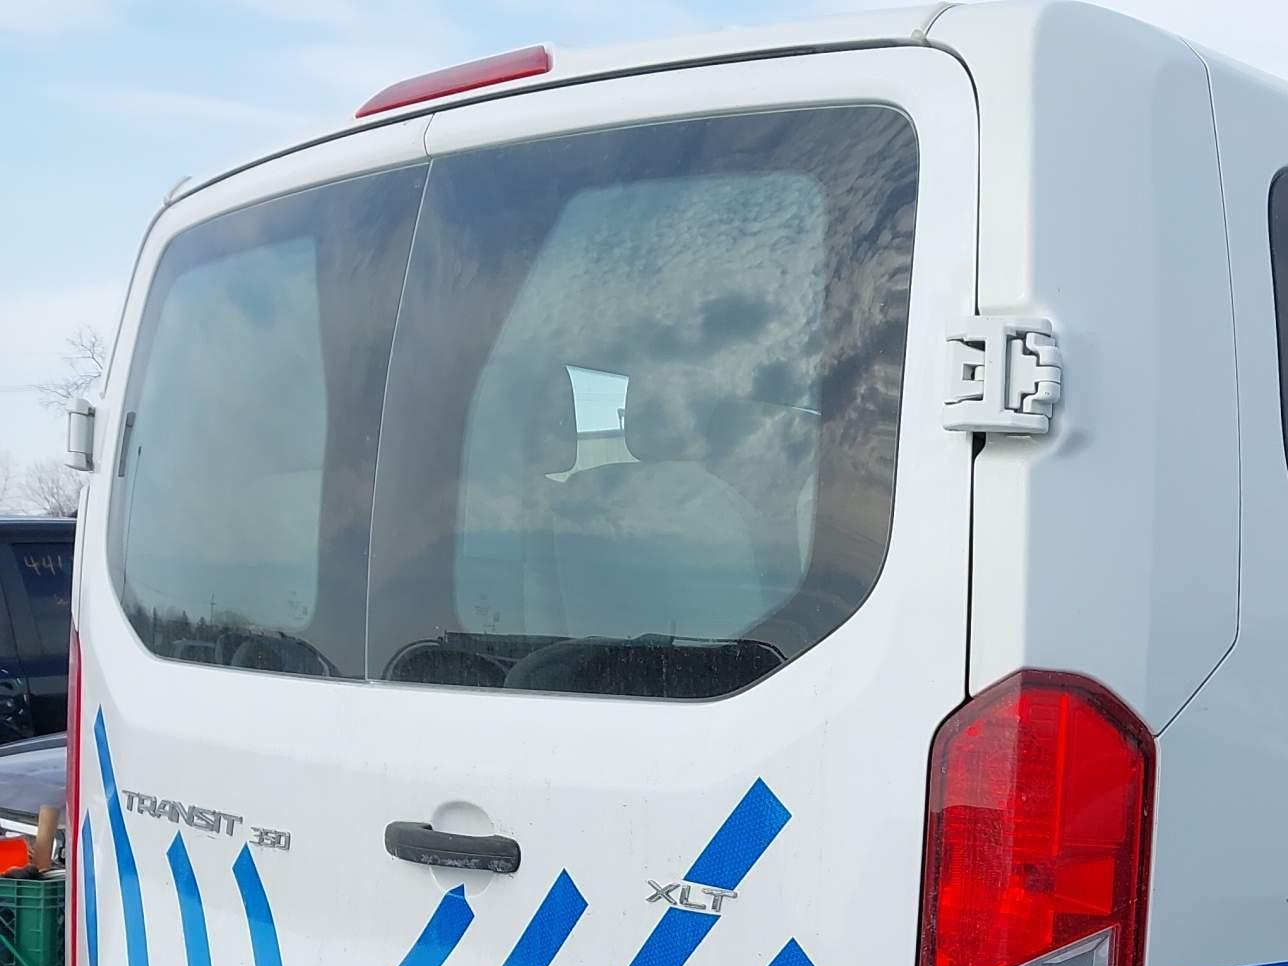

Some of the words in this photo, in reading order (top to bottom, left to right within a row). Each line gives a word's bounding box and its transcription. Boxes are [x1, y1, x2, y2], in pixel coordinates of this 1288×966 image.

[121, 789, 243, 836] TRANSIT
[249, 826, 292, 850] 350
[645, 880, 738, 912] XLT
